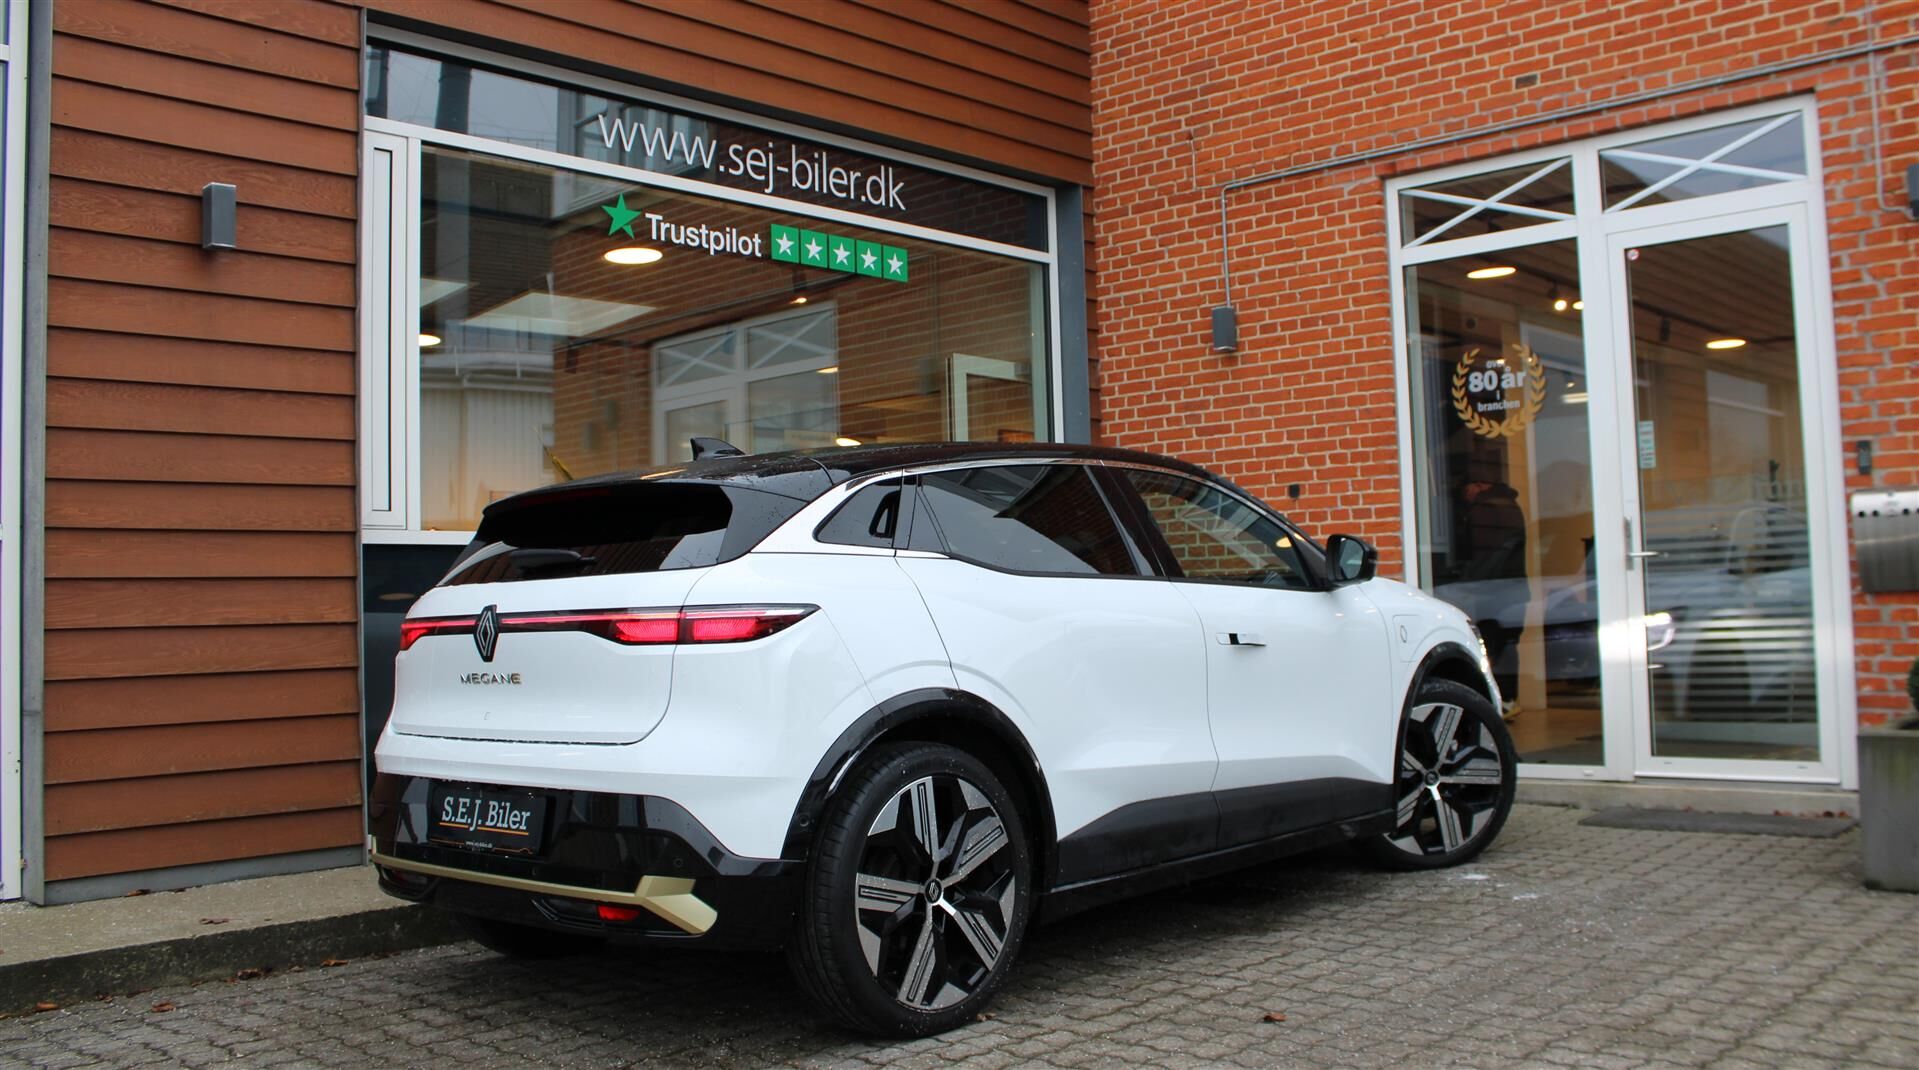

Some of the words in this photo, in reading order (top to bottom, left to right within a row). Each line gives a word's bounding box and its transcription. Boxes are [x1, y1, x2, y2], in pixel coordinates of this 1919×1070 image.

[598, 114, 906, 210] www.sej-biler.dk
[645, 213, 762, 257] Trustpilot
[1469, 370, 1498, 393] 80
[1501, 366, 1527, 389] år
[1477, 400, 1520, 412] branchen
[1496, 390, 1501, 400] i
[460, 672, 521, 684] MEGANE
[441, 796, 482, 832] S.E.J.
[485, 800, 531, 830] Biler
